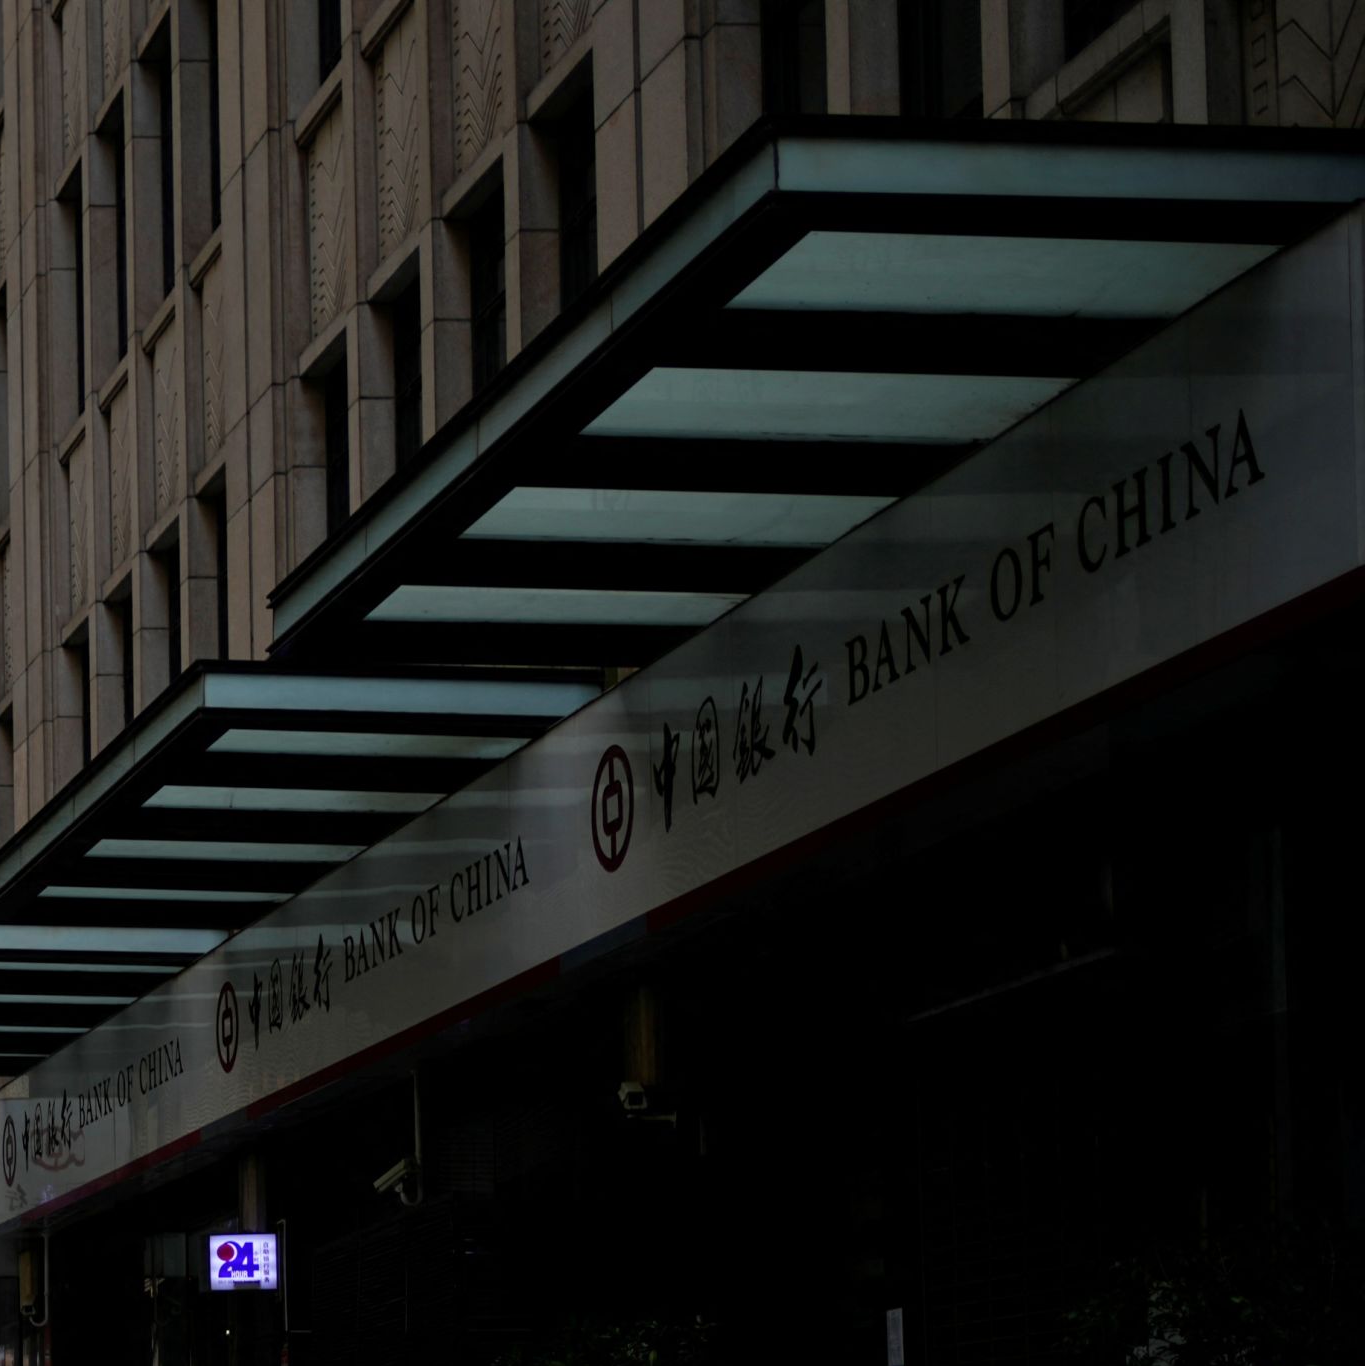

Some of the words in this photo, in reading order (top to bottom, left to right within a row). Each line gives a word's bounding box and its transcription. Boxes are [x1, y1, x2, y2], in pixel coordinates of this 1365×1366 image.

[845, 575, 969, 705] BANK
[989, 523, 1055, 621] OF
[1076, 408, 1265, 573] CHINA
[343, 907, 403, 983] BANK
[412, 884, 440, 944] OF
[450, 835, 529, 923] CHINA
[78, 1077, 112, 1129] BANK
[117, 1064, 134, 1107] OF
[139, 1036, 184, 1095] CHINA
[217, 1241, 259, 1278] 24
[231, 1270, 248, 1278] HOUR
